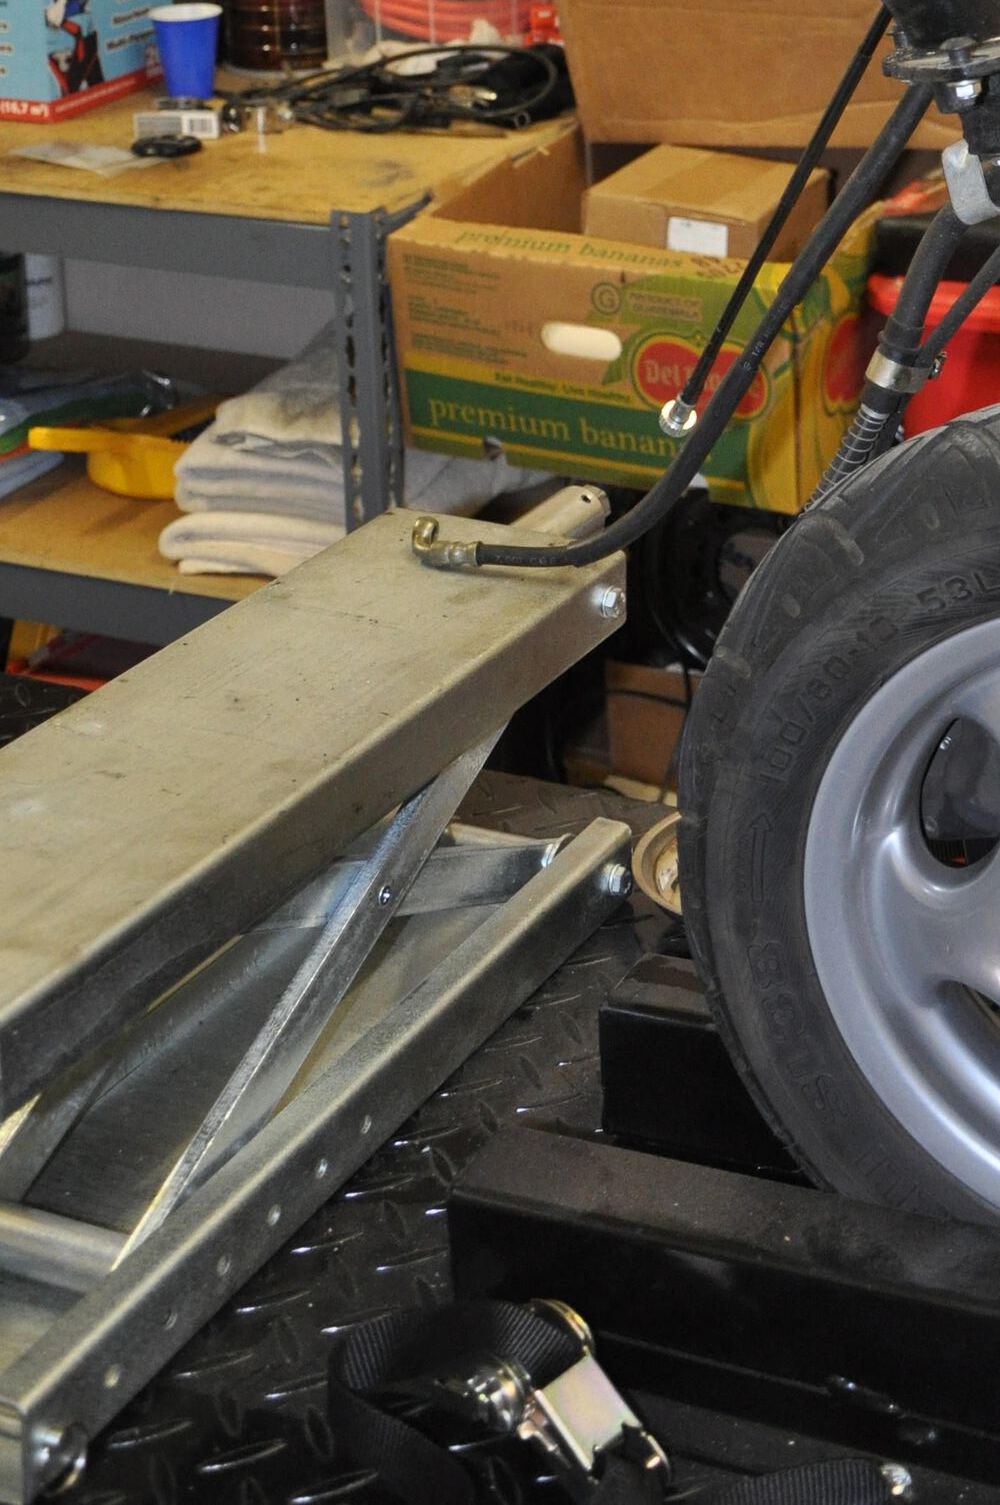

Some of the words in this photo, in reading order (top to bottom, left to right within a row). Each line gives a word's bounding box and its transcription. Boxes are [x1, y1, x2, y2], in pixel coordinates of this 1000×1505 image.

[458, 228, 571, 254] premium
[579, 239, 683, 269] bananas
[644, 359, 681, 386] Del
[427, 397, 571, 444] premium
[579, 416, 713, 463] banan
